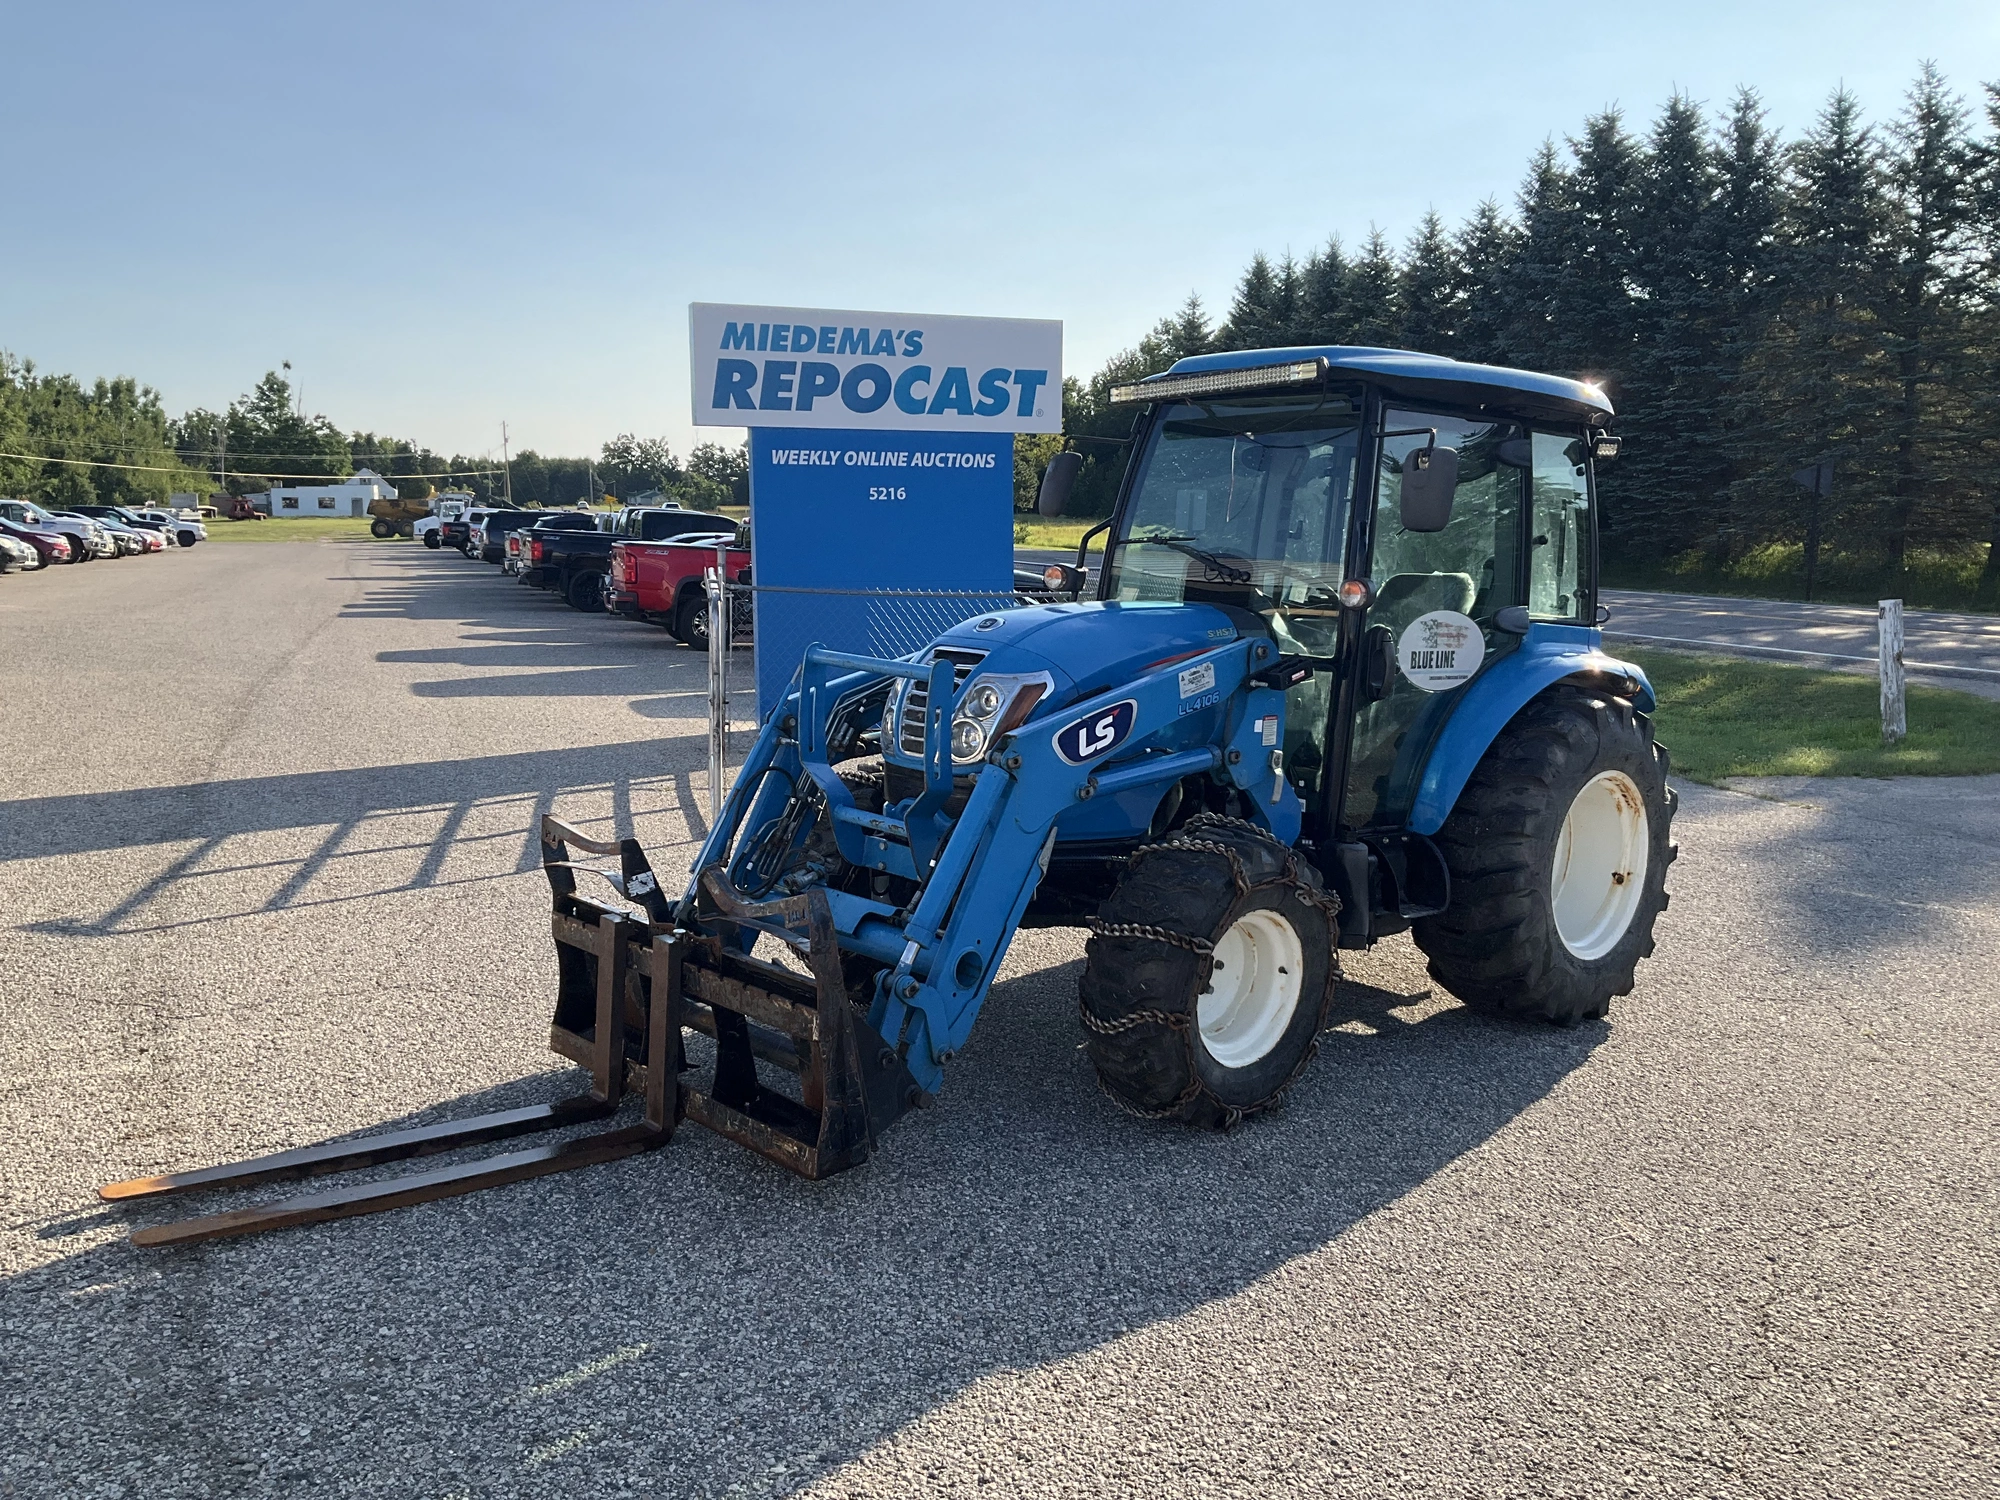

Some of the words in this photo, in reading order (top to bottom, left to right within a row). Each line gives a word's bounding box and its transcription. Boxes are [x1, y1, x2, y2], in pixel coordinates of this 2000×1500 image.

[719, 321, 924, 358] MIEDEMA'S
[711, 358, 1048, 418] REPOCAST
[771, 449, 841, 467] WEEKLY
[844, 450, 908, 468] ONLINE
[910, 451, 996, 468] AUCTIONS
[868, 487, 906, 501] 5216
[1410, 650, 1434, 670] BLUE
[1435, 650, 1455, 669] LINE
[1178, 690, 1220, 716] LL4106
[1079, 715, 1115, 757] LS
